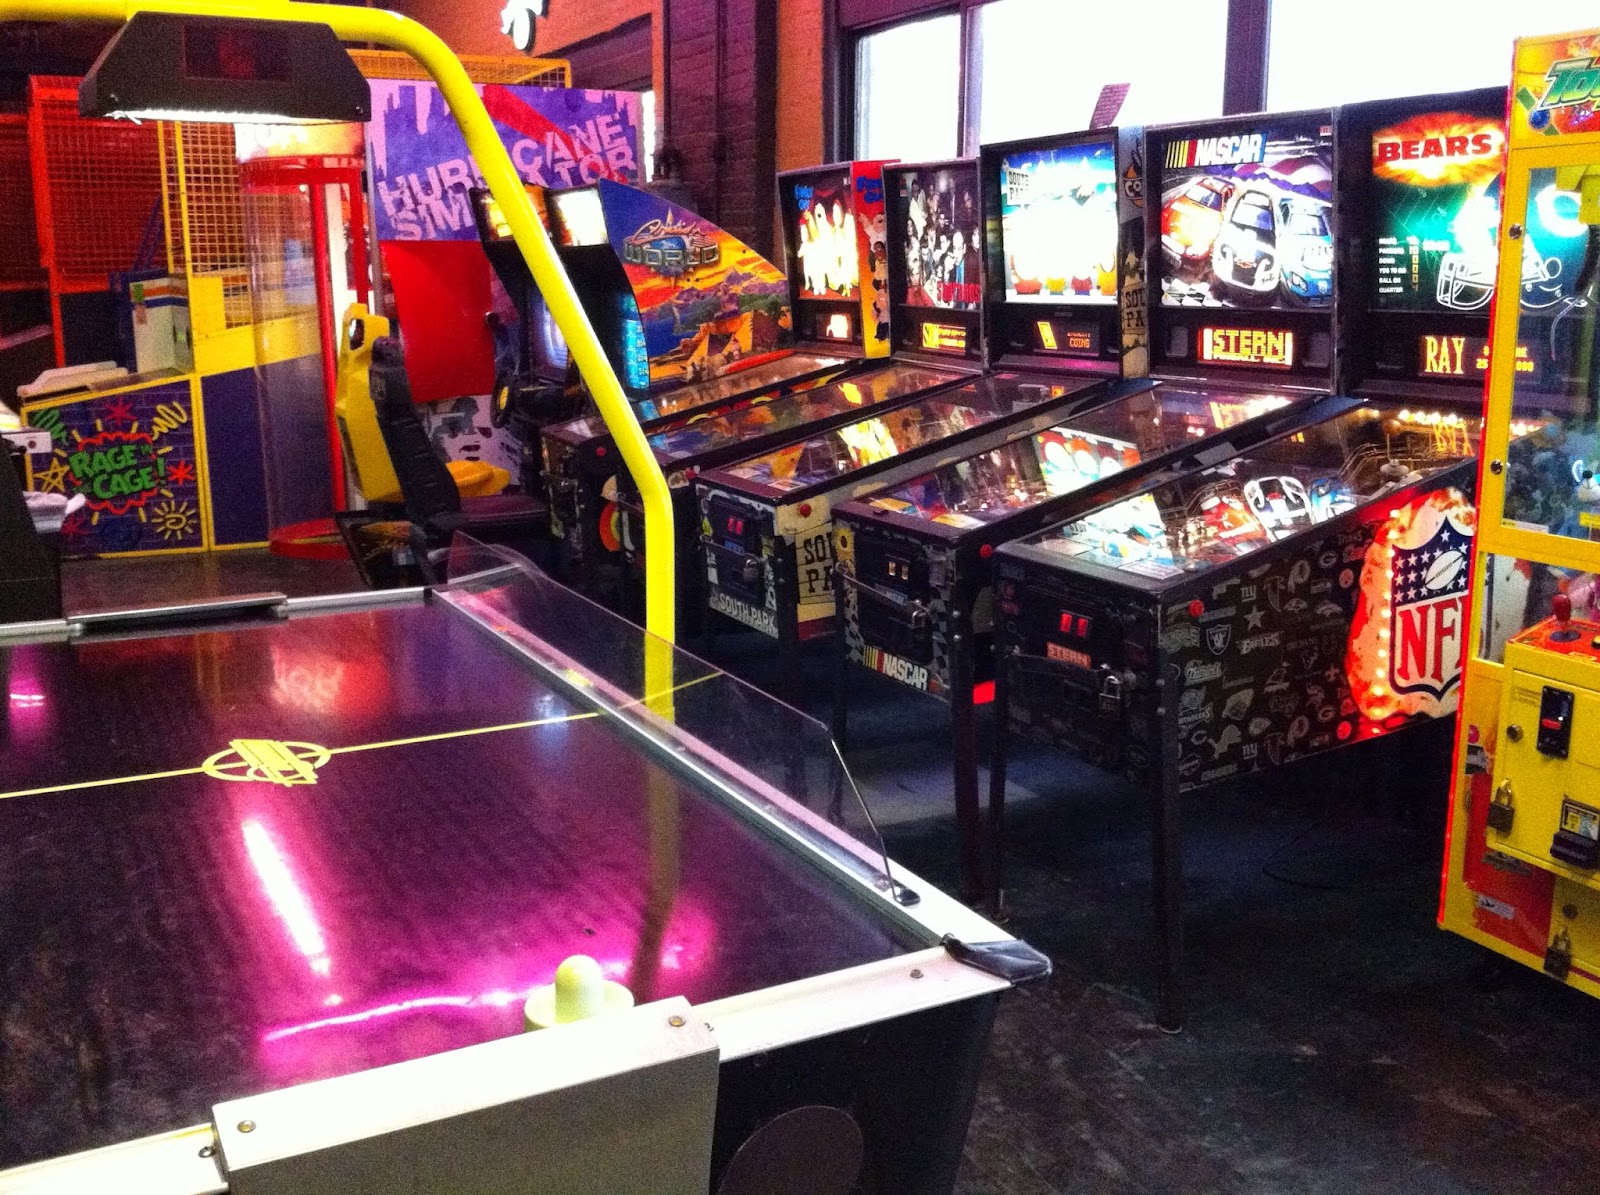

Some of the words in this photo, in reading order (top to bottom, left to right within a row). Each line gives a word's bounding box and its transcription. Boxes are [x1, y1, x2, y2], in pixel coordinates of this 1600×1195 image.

[1541, 57, 1600, 108] TO
[378, 113, 629, 218] HURCANE
[1194, 133, 1263, 167] NASCAR
[1377, 134, 1493, 162] BEARS
[394, 145, 637, 241] SIMTOR
[1212, 329, 1285, 358] STERN
[1424, 336, 1466, 375] RAY
[69, 444, 138, 478] RAGE
[720, 593, 750, 623] SOUTH
[750, 606, 777, 635] PARK
[1047, 642, 1092, 669] STERN
[1397, 594, 1465, 683] NF
[882, 652, 929, 692] NASCAR
